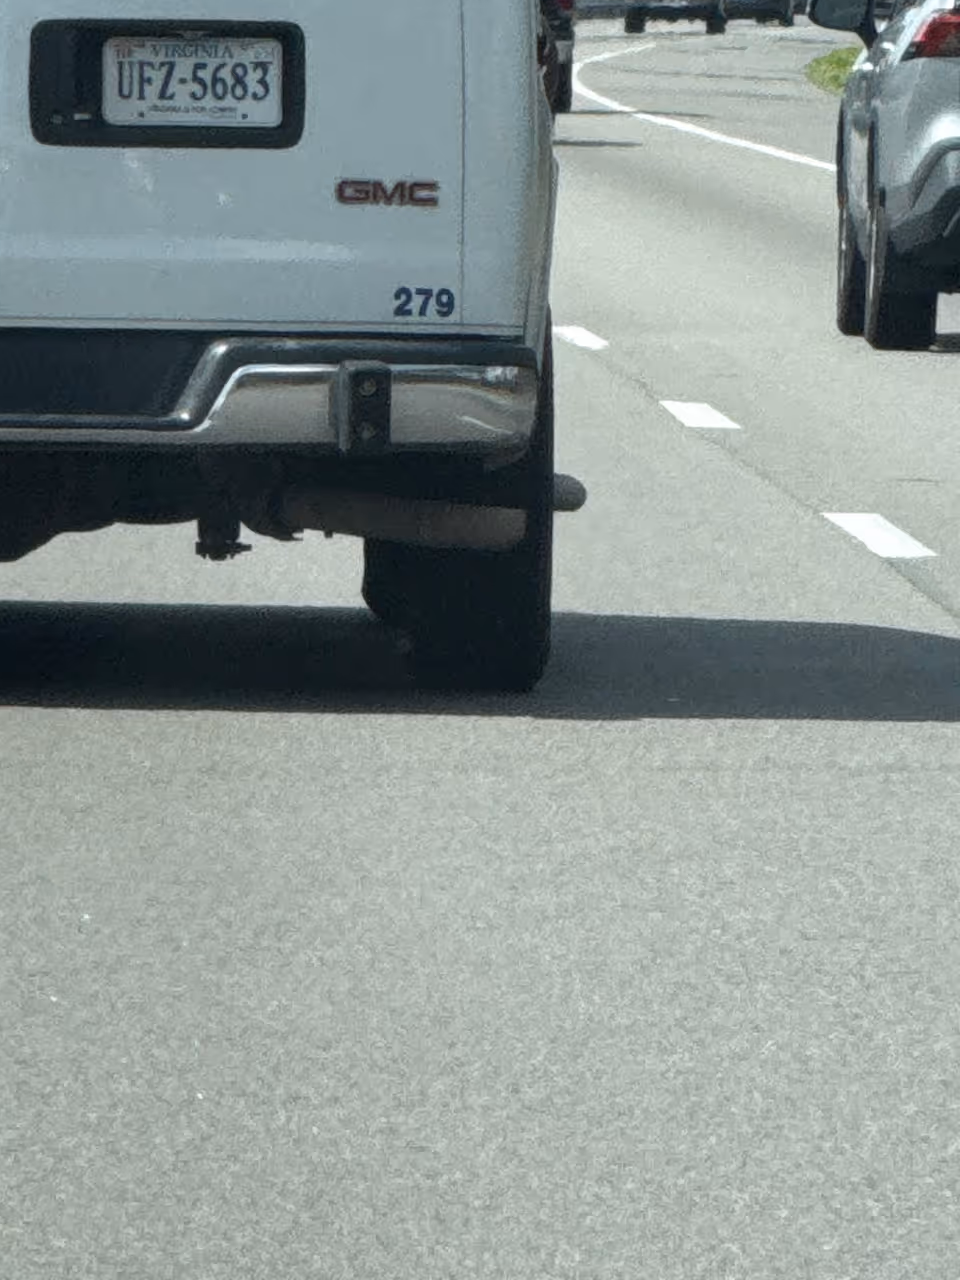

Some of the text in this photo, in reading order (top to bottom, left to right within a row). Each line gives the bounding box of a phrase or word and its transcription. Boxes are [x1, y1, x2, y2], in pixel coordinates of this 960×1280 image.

[150, 43, 234, 60] VIRGINIA
[116, 60, 271, 101] UFZ-5683
[336, 180, 439, 207] GMC
[393, 287, 455, 317] 279
